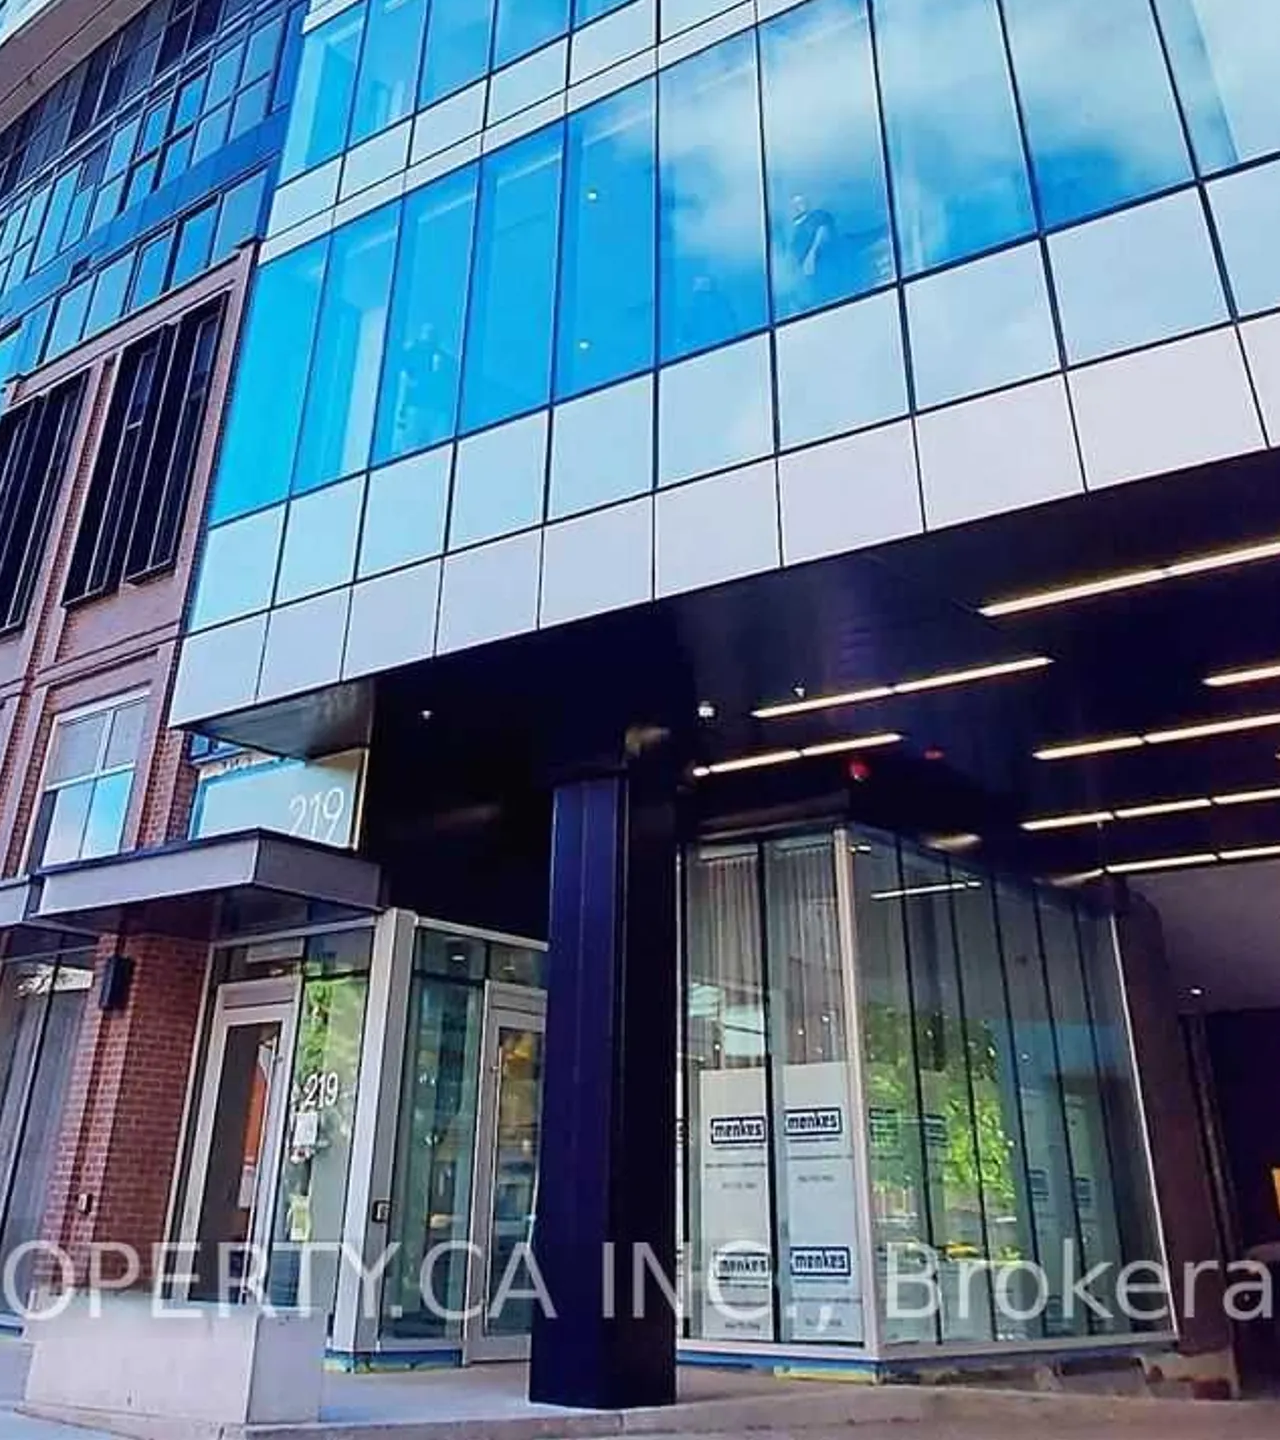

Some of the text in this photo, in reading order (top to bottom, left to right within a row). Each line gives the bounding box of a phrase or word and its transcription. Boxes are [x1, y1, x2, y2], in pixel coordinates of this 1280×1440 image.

[288, 787, 345, 843] 219
[303, 1071, 339, 1108] 219
[713, 1119, 763, 1139] menkes
[786, 1111, 838, 1131] menkes
[793, 1250, 847, 1271] menkes
